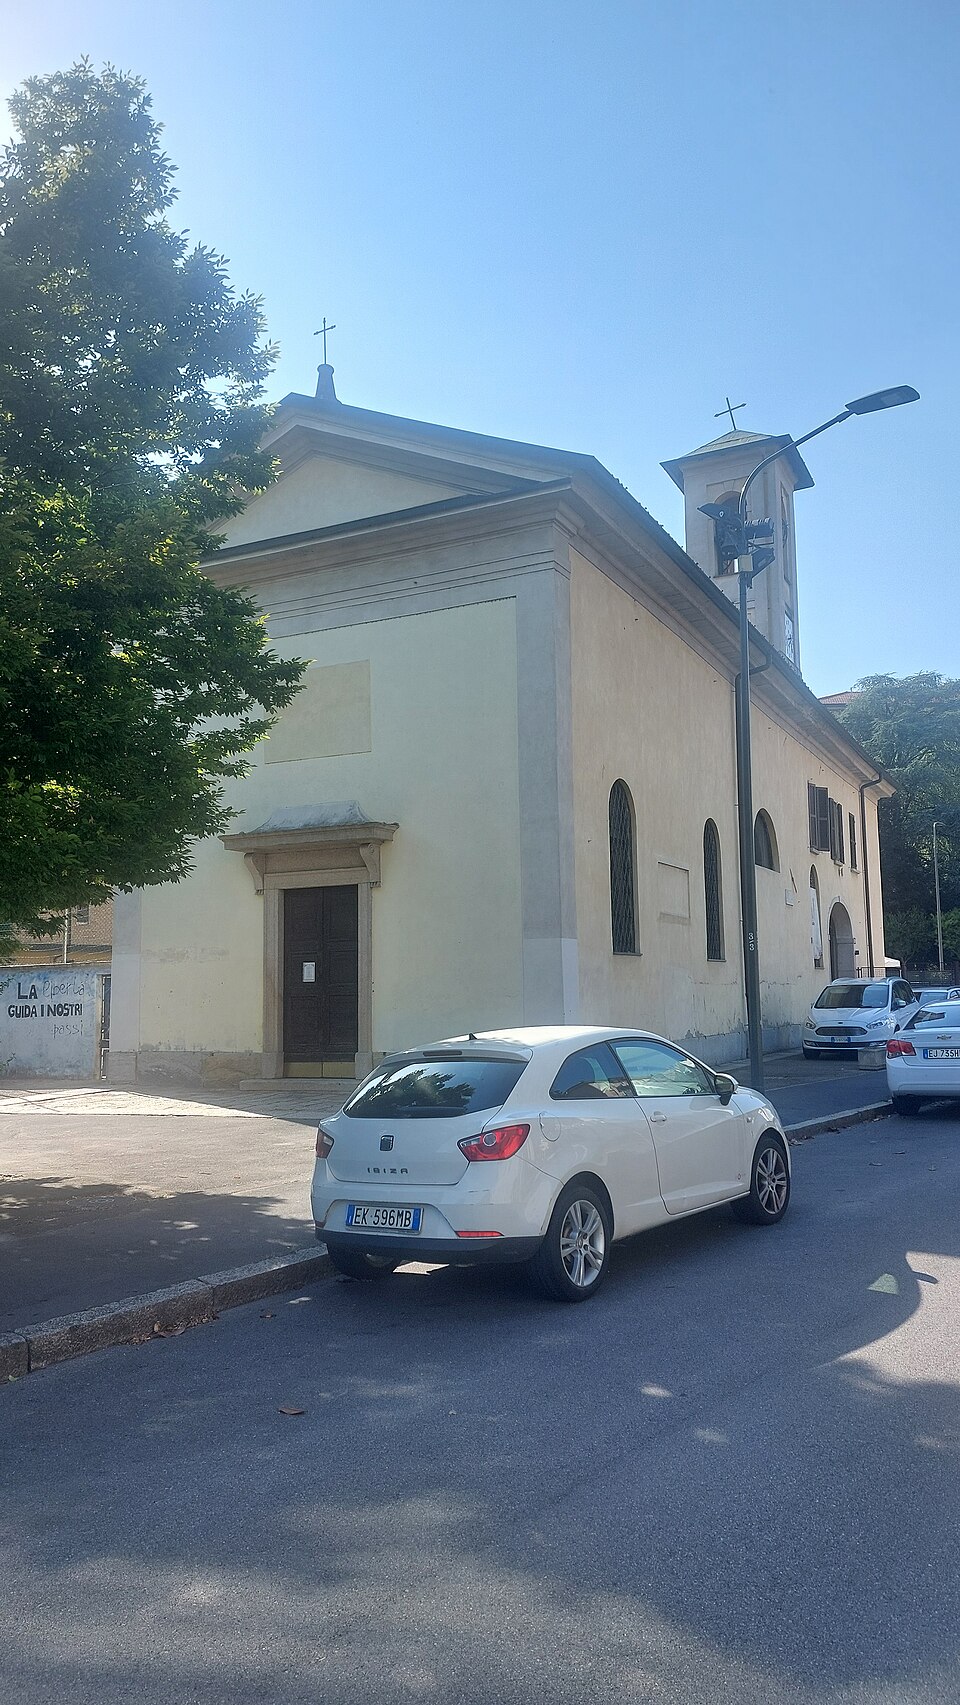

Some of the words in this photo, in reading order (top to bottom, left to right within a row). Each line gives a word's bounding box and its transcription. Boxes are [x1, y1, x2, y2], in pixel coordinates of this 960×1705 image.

[17, 982, 38, 1000] LA
[8, 1004, 38, 1018] GUIDA
[47, 1003, 83, 1017] NOSTRI
[940, 1049, 960, 1058] 735H
[354, 1207, 370, 1225] EK
[373, 1208, 412, 1228] 596MB
